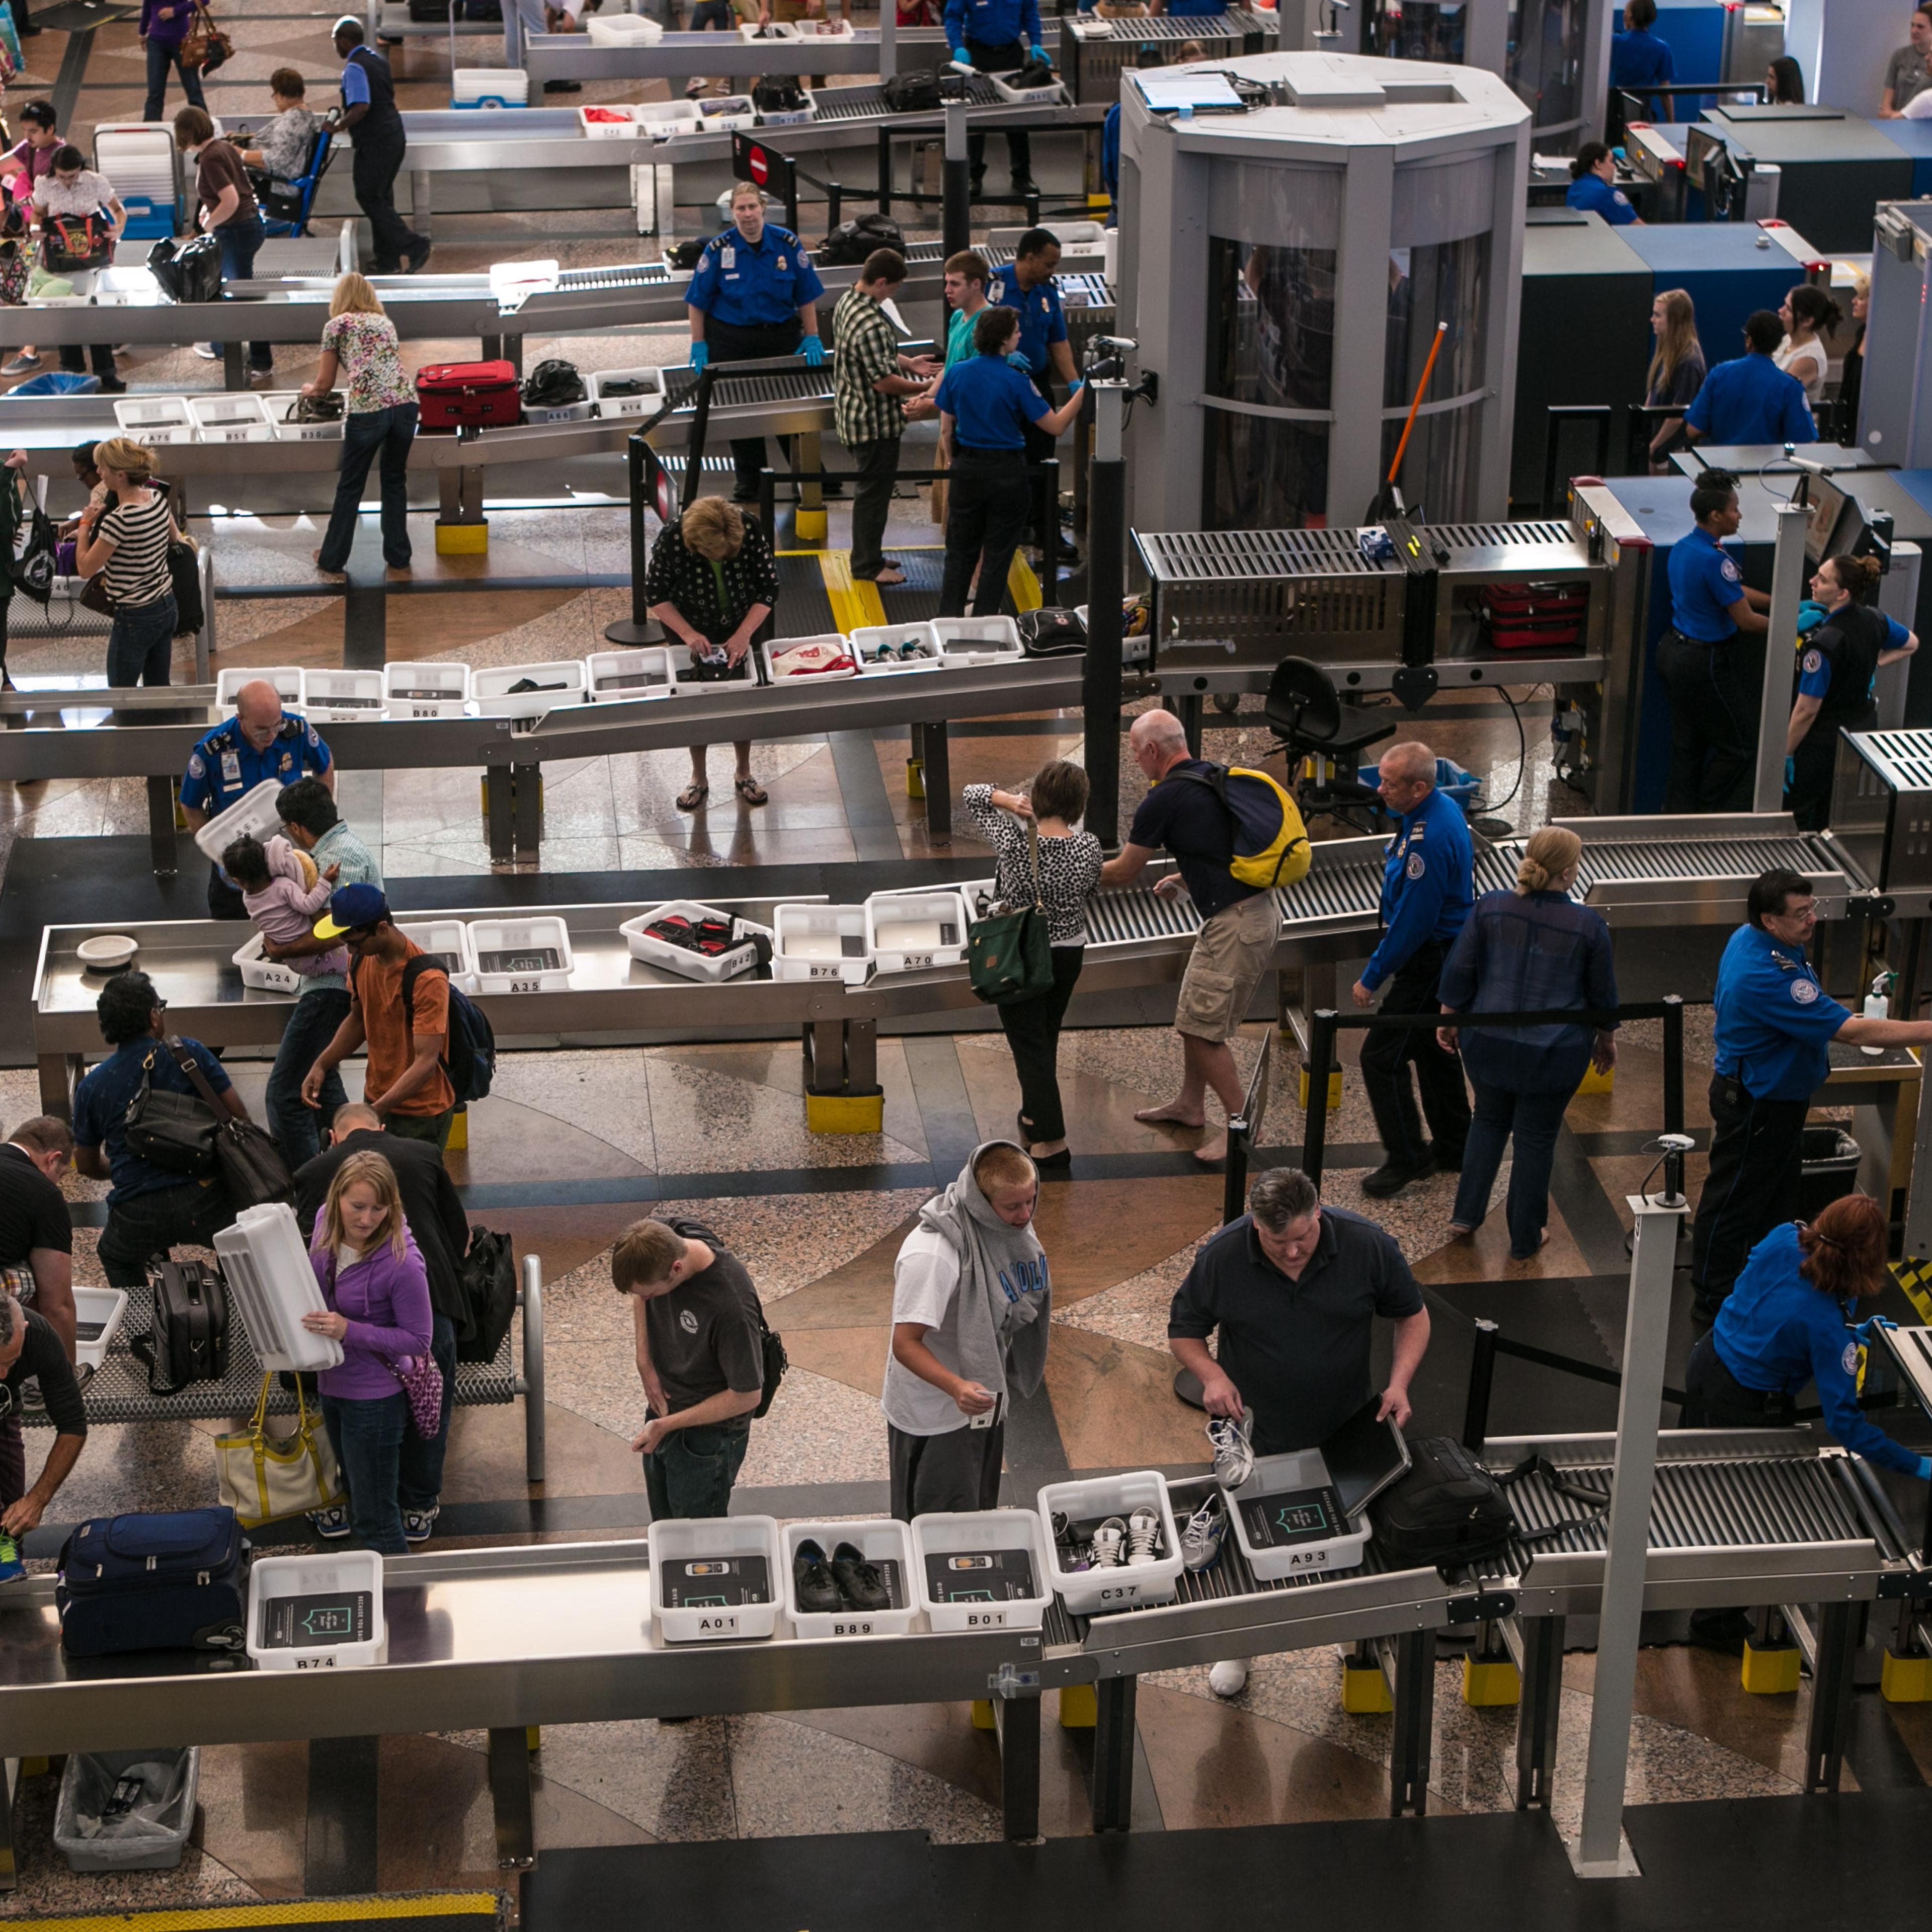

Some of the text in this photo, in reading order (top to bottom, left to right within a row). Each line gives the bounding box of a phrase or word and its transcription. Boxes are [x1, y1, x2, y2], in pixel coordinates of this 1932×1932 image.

[732, 953, 750, 968] B42
[904, 956, 931, 965] A70
[811, 968, 837, 976] B76
[266, 973, 290, 983] A24
[512, 982, 538, 992] A35
[1322, 1491, 1331, 1513] BECAUSE
[1329, 1513, 1337, 1524] YOU
[1291, 1551, 1326, 1565] A93
[883, 1564, 892, 1585] BECAUSE
[1101, 1586, 1136, 1599] C37
[700, 1618, 734, 1629] A01
[969, 1615, 1002, 1625] B01
[835, 1624, 870, 1634] B89
[298, 1657, 333, 1669] B74
